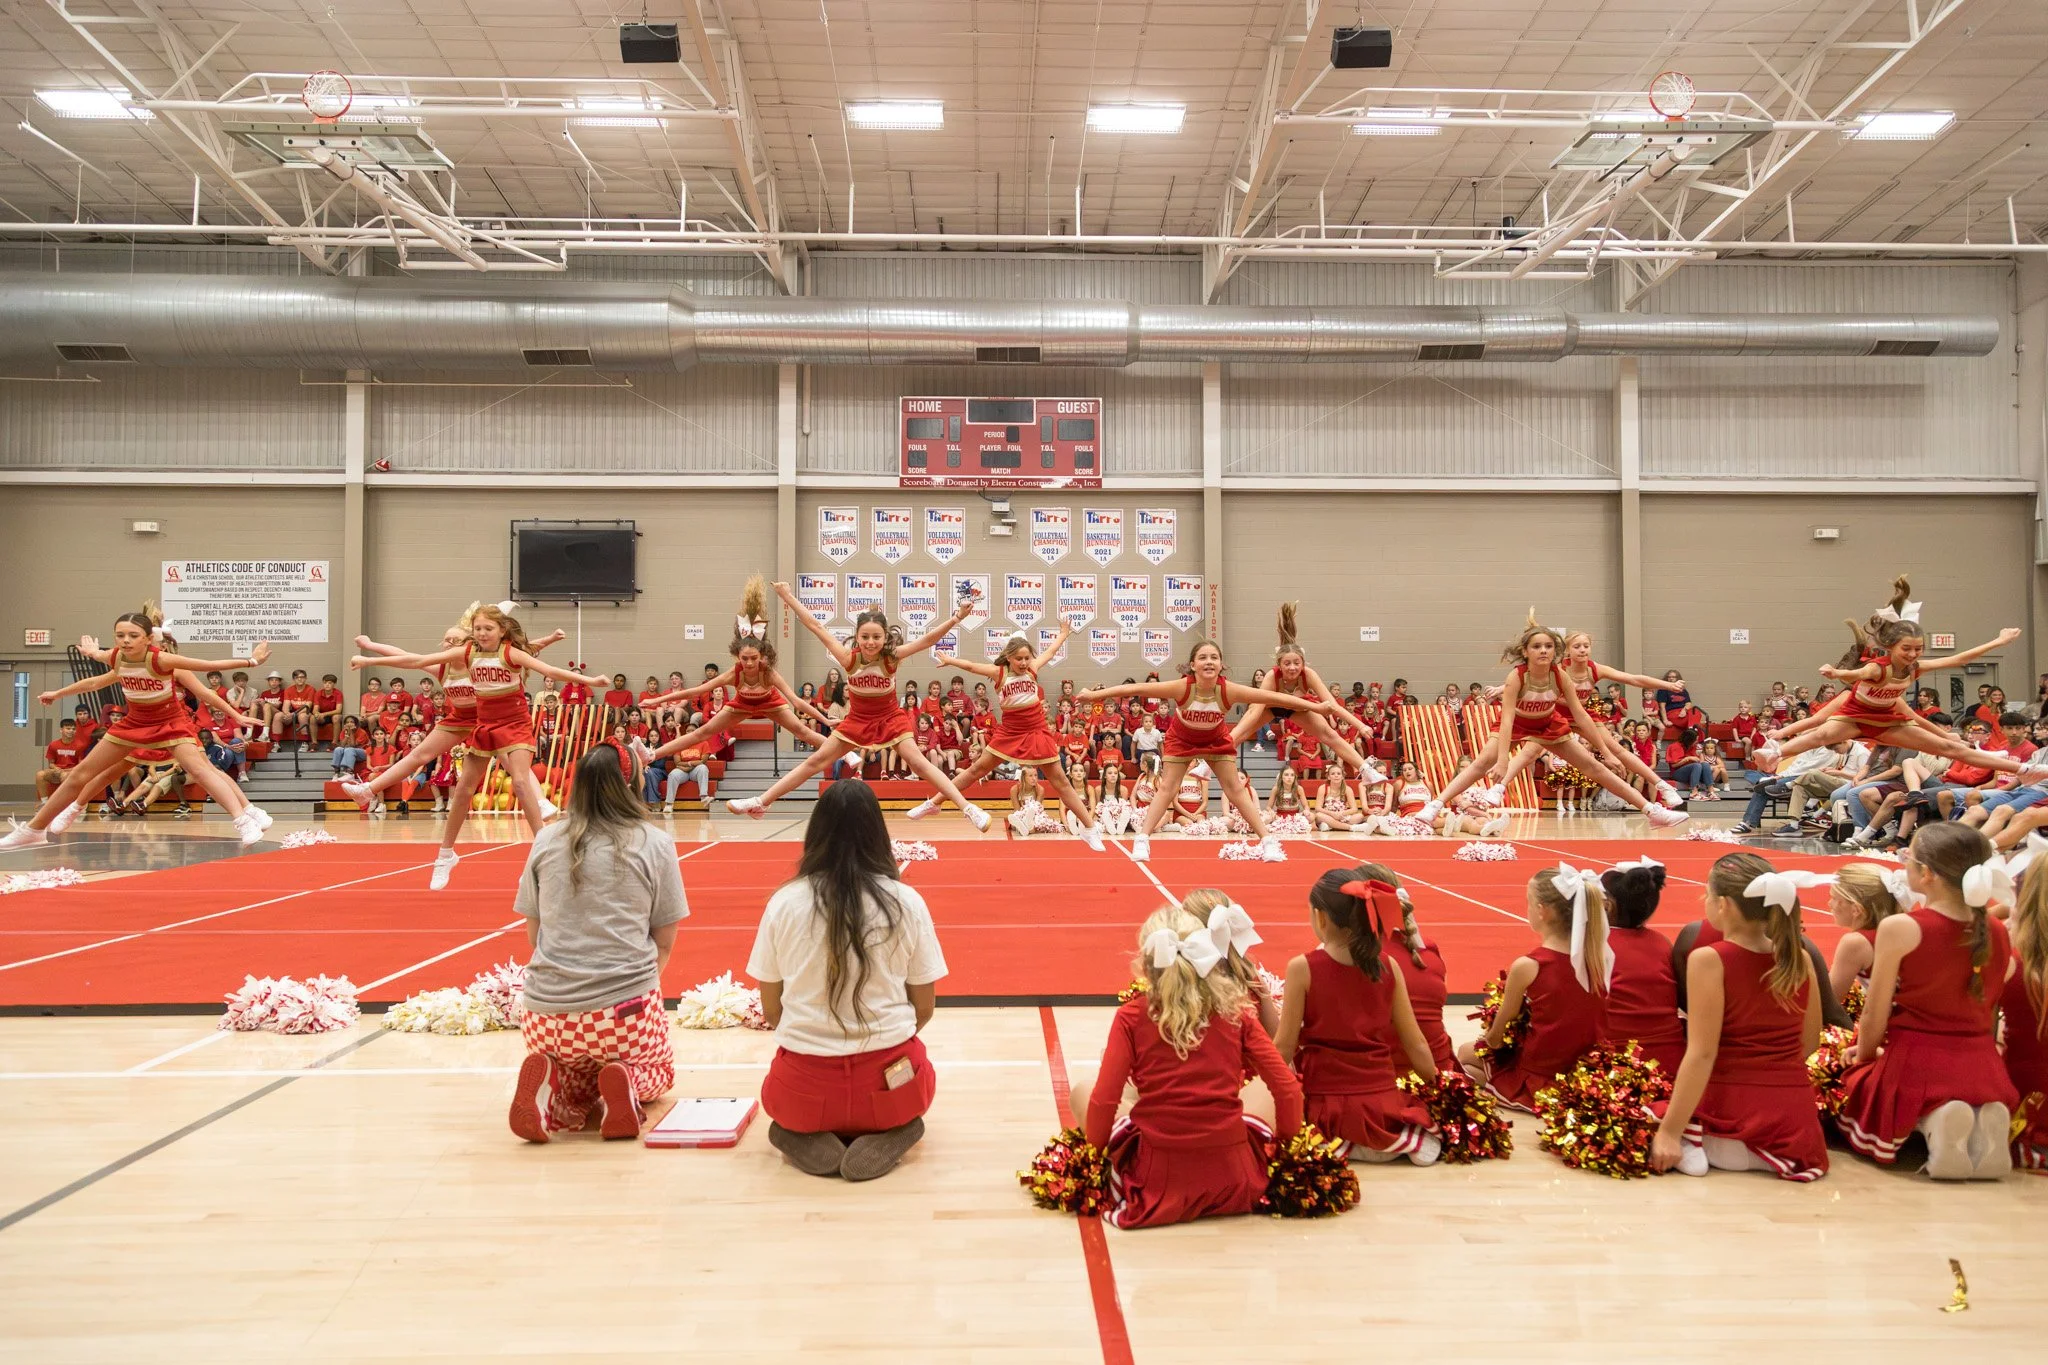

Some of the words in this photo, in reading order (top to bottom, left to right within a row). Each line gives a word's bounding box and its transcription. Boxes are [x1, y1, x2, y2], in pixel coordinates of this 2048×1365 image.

[908, 401, 942, 412] HOME
[1058, 402, 1094, 414] GUEST
[980, 479, 988, 488] by
[822, 538, 857, 546] CHAMPIONS
[830, 548, 848, 556] 2018
[186, 563, 229, 572] ATHLETICS
[232, 563, 253, 572] CODE
[256, 563, 265, 572] OF
[268, 563, 306, 572] CONDUCT
[1167, 606, 1200, 614] CHAMPION
[30, 632, 46, 643] EXIT
[1936, 636, 1951, 646] EXIT
[848, 674, 890, 688] WARRIORS
[1002, 680, 1035, 698] WARRIORS
